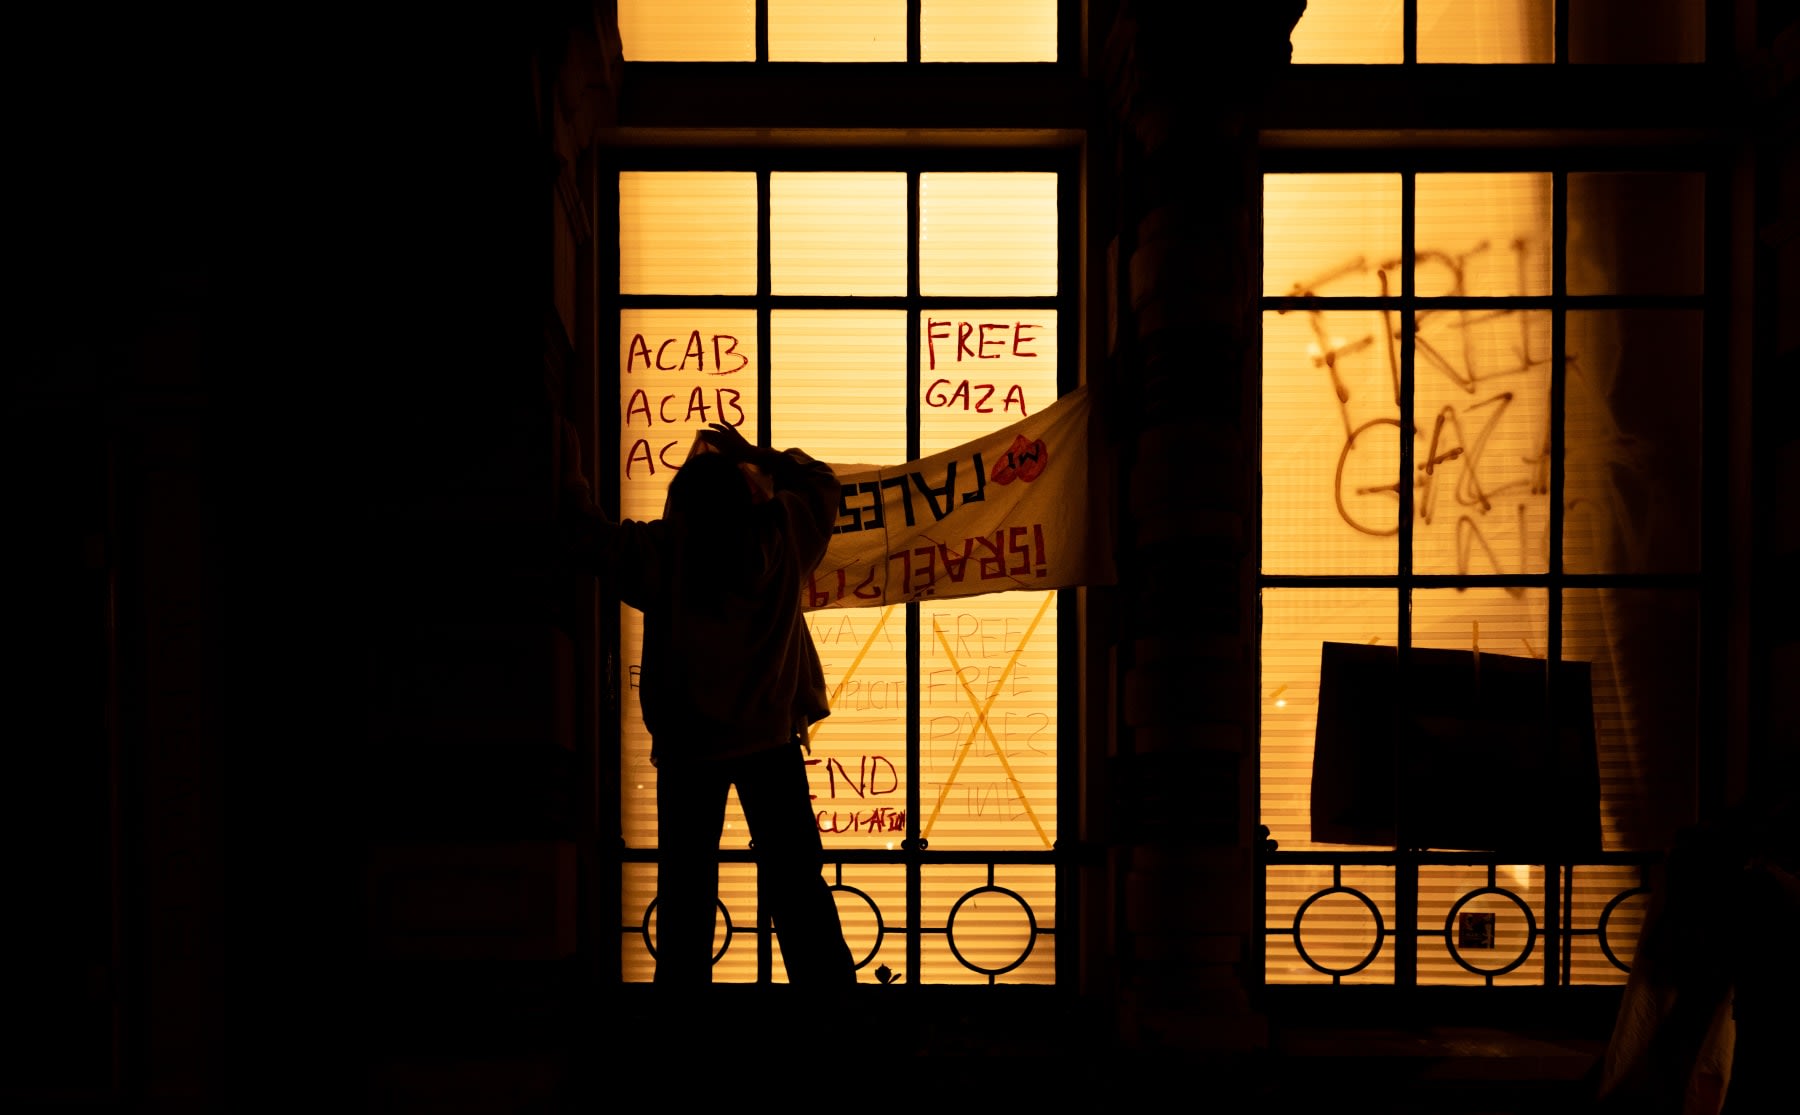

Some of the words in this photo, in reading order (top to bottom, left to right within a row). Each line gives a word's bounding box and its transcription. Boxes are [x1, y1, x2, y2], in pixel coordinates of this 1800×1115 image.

[626, 330, 749, 376] ACAB
[927, 317, 1044, 370] FREE
[626, 386, 745, 428] ACAB
[925, 378, 1027, 417] GAZA
[626, 438, 682, 480] AC
[832, 452, 986, 535] PALES
[932, 613, 1024, 659] FREE
[827, 680, 905, 712] MPLICIT
[927, 661, 1033, 705] FREE
